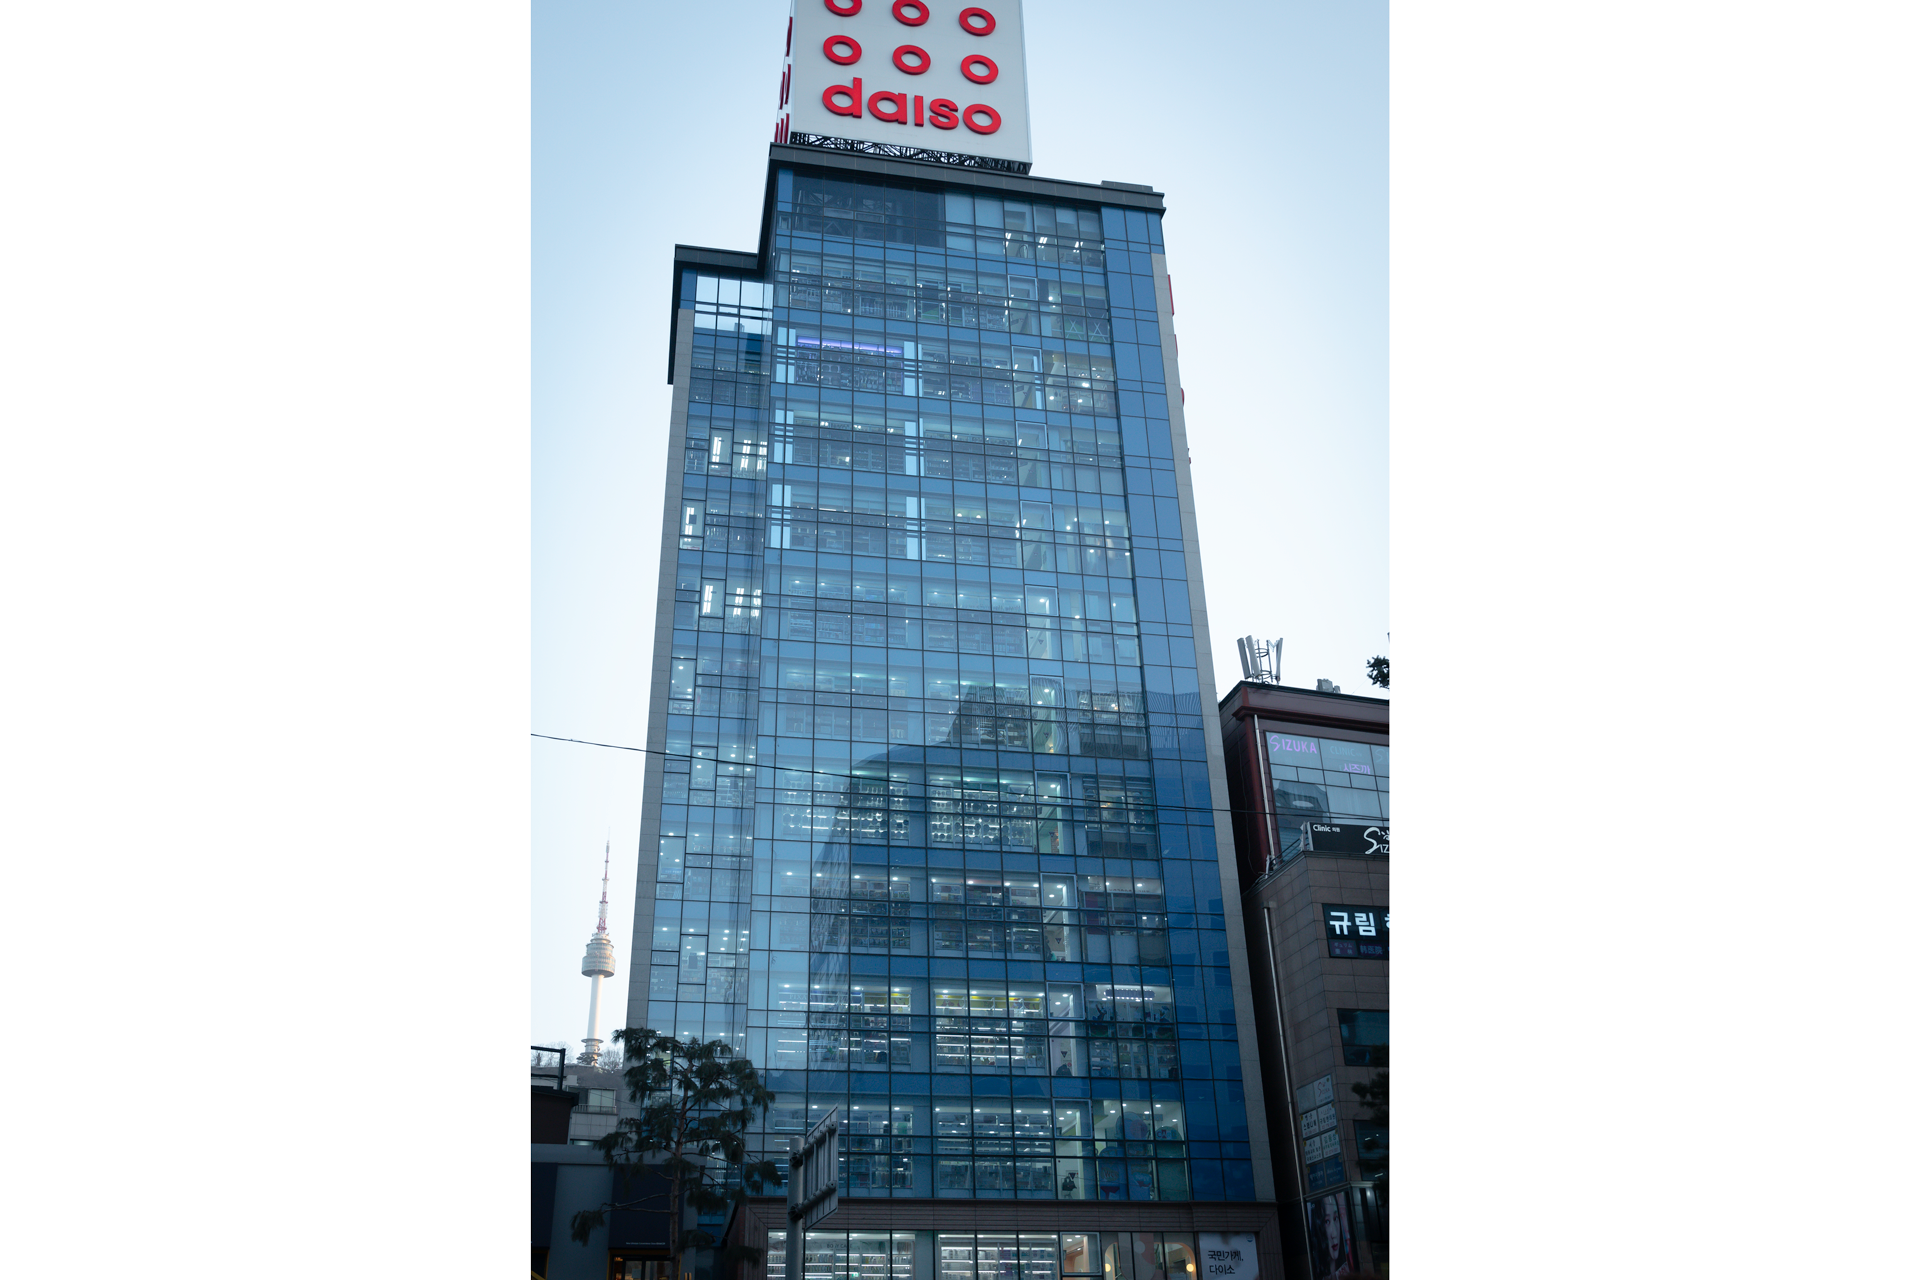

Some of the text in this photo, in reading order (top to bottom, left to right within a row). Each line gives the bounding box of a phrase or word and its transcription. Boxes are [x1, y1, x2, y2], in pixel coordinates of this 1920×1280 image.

[822, 77, 1002, 135] daiso
[1269, 735, 1317, 754] SIZUKA
[1330, 745, 1355, 757] CLINIC
[1312, 824, 1331, 832] Clinic
[1207, 1250, 1244, 1262] 국민가게,
[1209, 1264, 1236, 1275] 다이소
